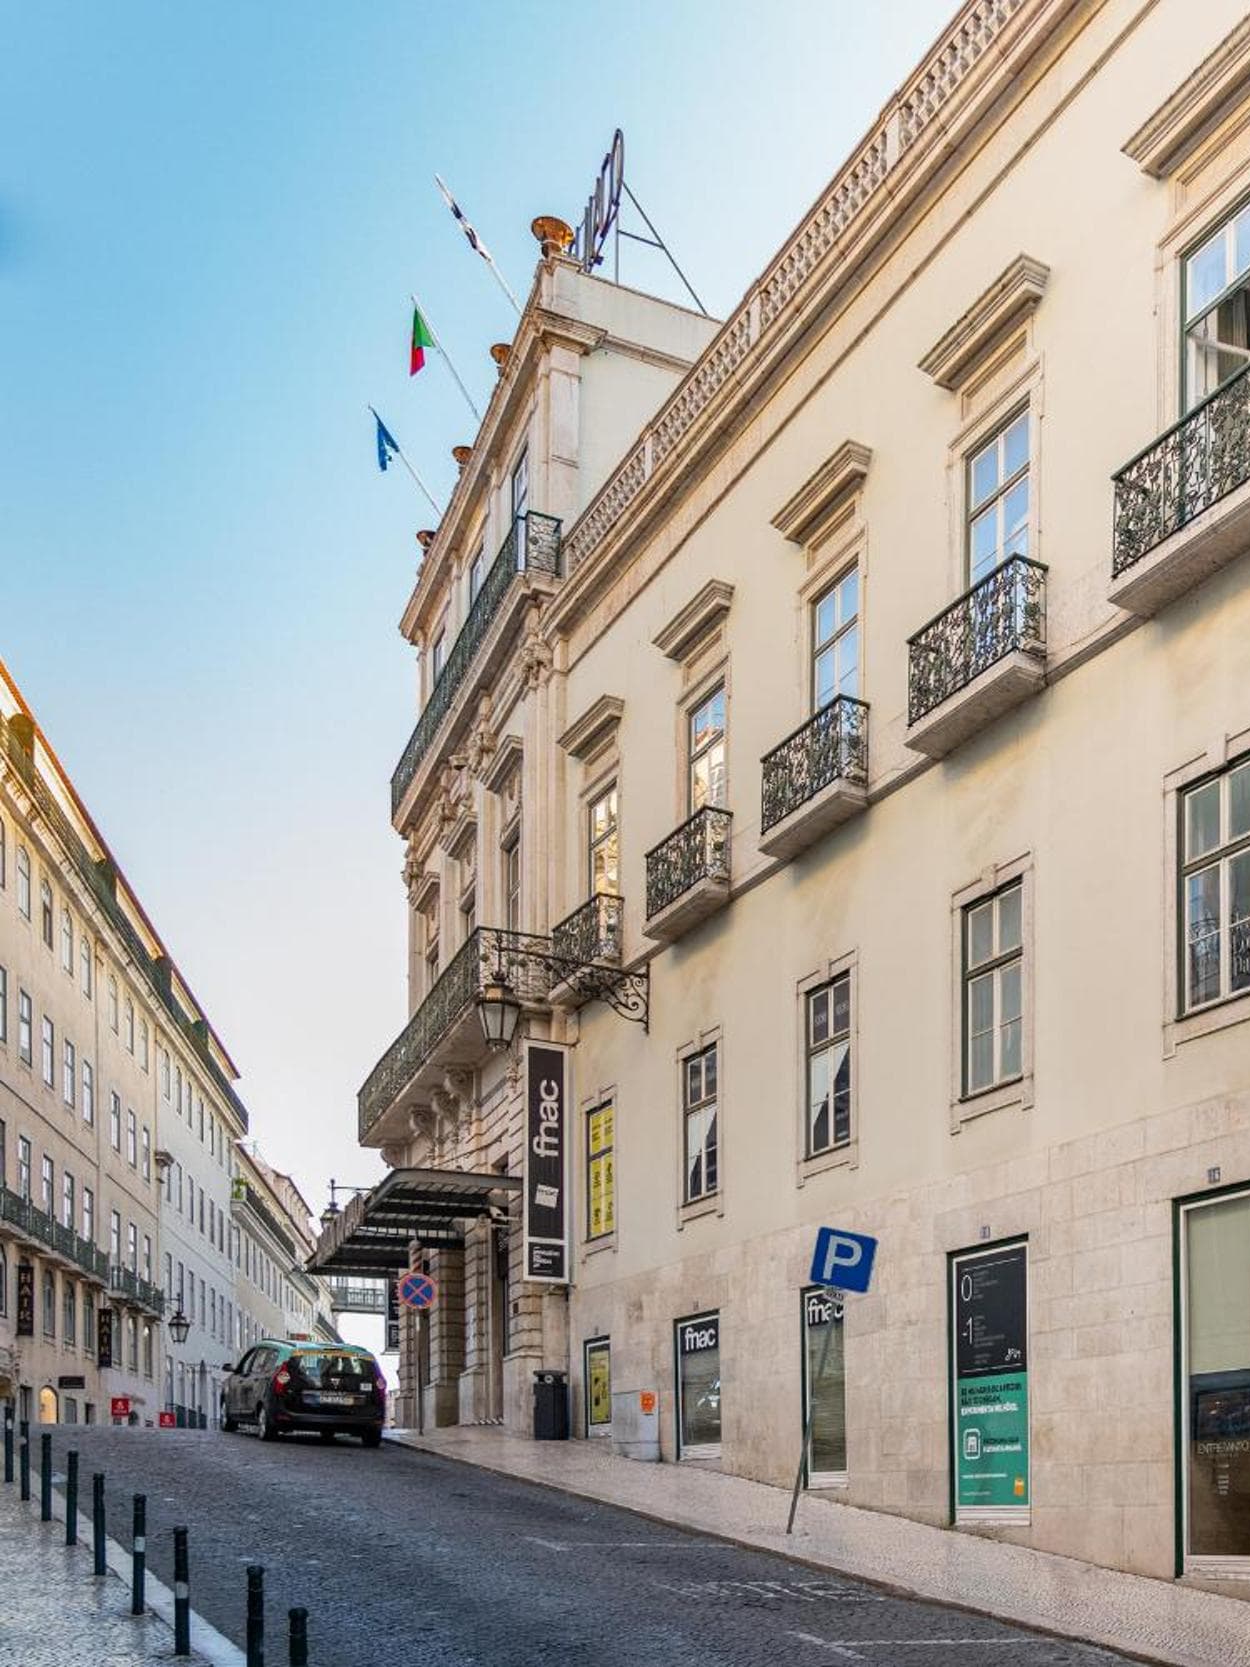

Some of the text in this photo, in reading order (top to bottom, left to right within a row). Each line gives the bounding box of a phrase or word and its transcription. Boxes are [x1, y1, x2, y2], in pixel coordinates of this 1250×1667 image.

[533, 1079, 560, 1158] fnac
[823, 1234, 863, 1280] P
[684, 1326, 717, 1351] fnac
